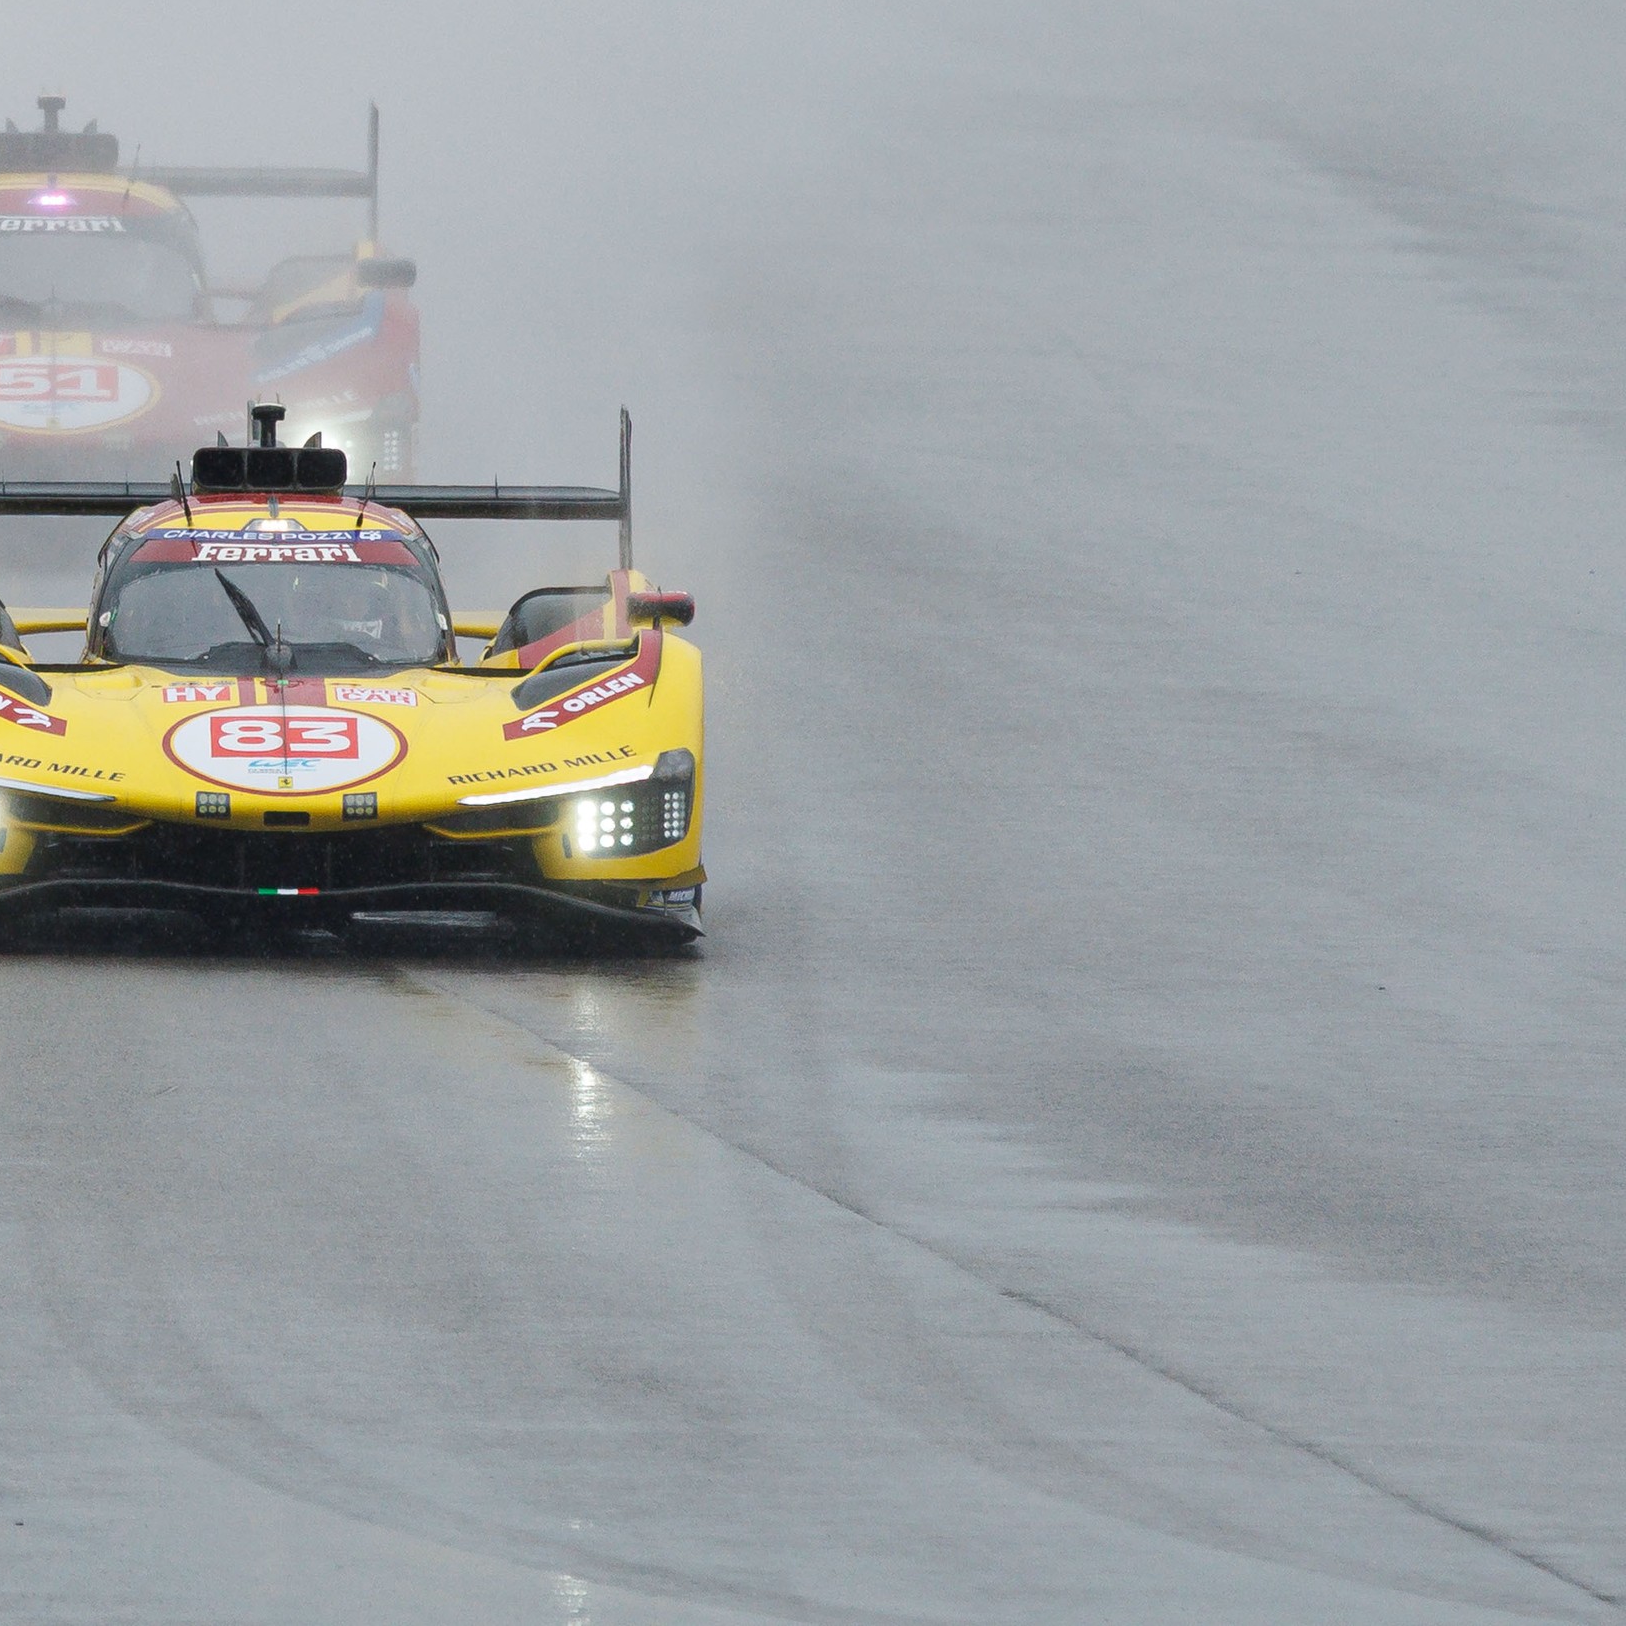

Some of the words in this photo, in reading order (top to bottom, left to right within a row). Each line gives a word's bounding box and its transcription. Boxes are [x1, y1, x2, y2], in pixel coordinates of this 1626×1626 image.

[163, 529, 274, 540] CHARLES
[281, 531, 352, 541] POZZI
[191, 542, 362, 562] Ferrari
[166, 685, 228, 702] HY
[342, 693, 411, 704] CAR
[562, 672, 645, 712] ORLEN
[218, 720, 350, 752] 83
[47, 762, 127, 782] MILLE
[447, 761, 558, 785] RICHARD
[564, 745, 638, 768] MILLE
